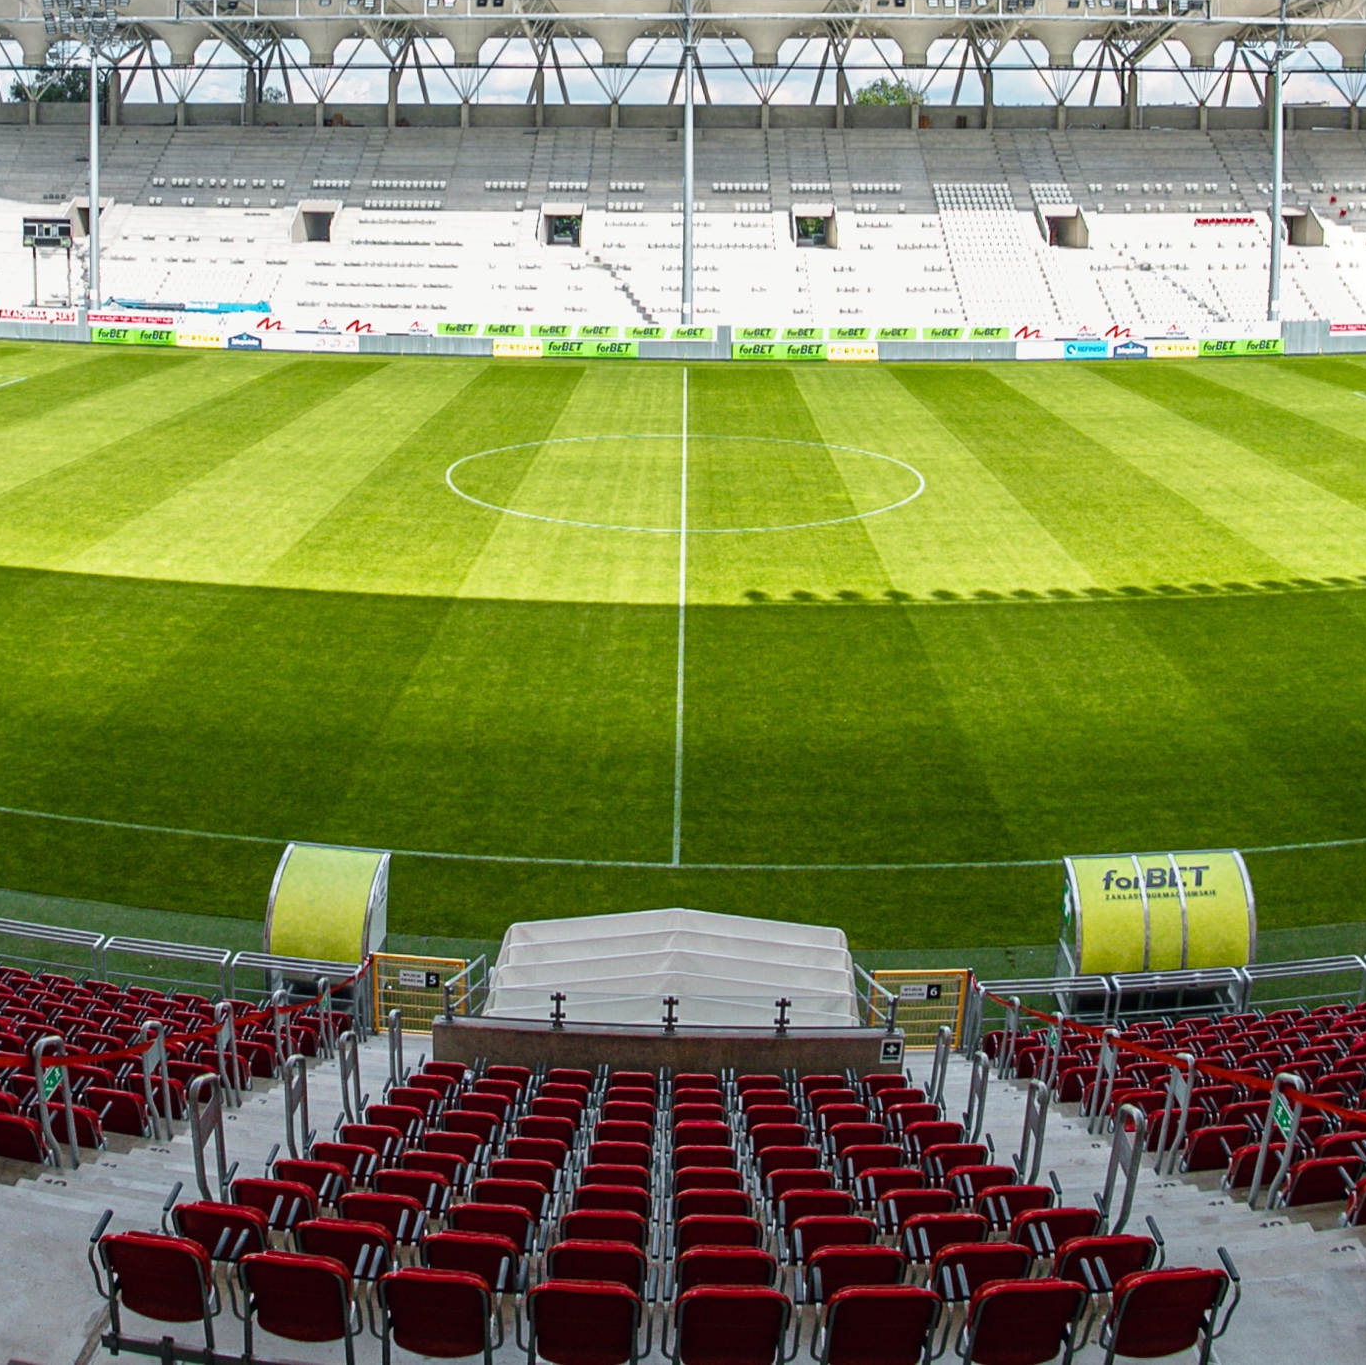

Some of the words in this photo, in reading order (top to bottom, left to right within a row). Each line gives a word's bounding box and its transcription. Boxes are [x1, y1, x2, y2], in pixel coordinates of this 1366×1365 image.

[445, 323, 473, 332] forBET
[489, 325, 516, 333] forBET
[539, 325, 566, 334] forBET
[582, 326, 610, 335] forBET
[633, 327, 661, 335] forBET
[676, 327, 705, 336] forBET
[881, 327, 908, 336] forBET
[973, 327, 1002, 335] forBET
[99, 328, 129, 339] forBET
[140, 329, 172, 341] forBET
[743, 328, 771, 337] forBET
[787, 328, 815, 337] forBET
[837, 328, 865, 337] forBET
[931, 328, 959, 337] forBET
[548, 341, 583, 351] forBET
[596, 343, 631, 353] forBET
[739, 344, 775, 354] forBET
[1203, 341, 1235, 351] forBET
[1246, 339, 1279, 350] forBET
[787, 344, 823, 355] forBET
[1102, 865, 1210, 891] forBET
[429, 975, 437, 985] 5
[929, 987, 939, 996] 6
